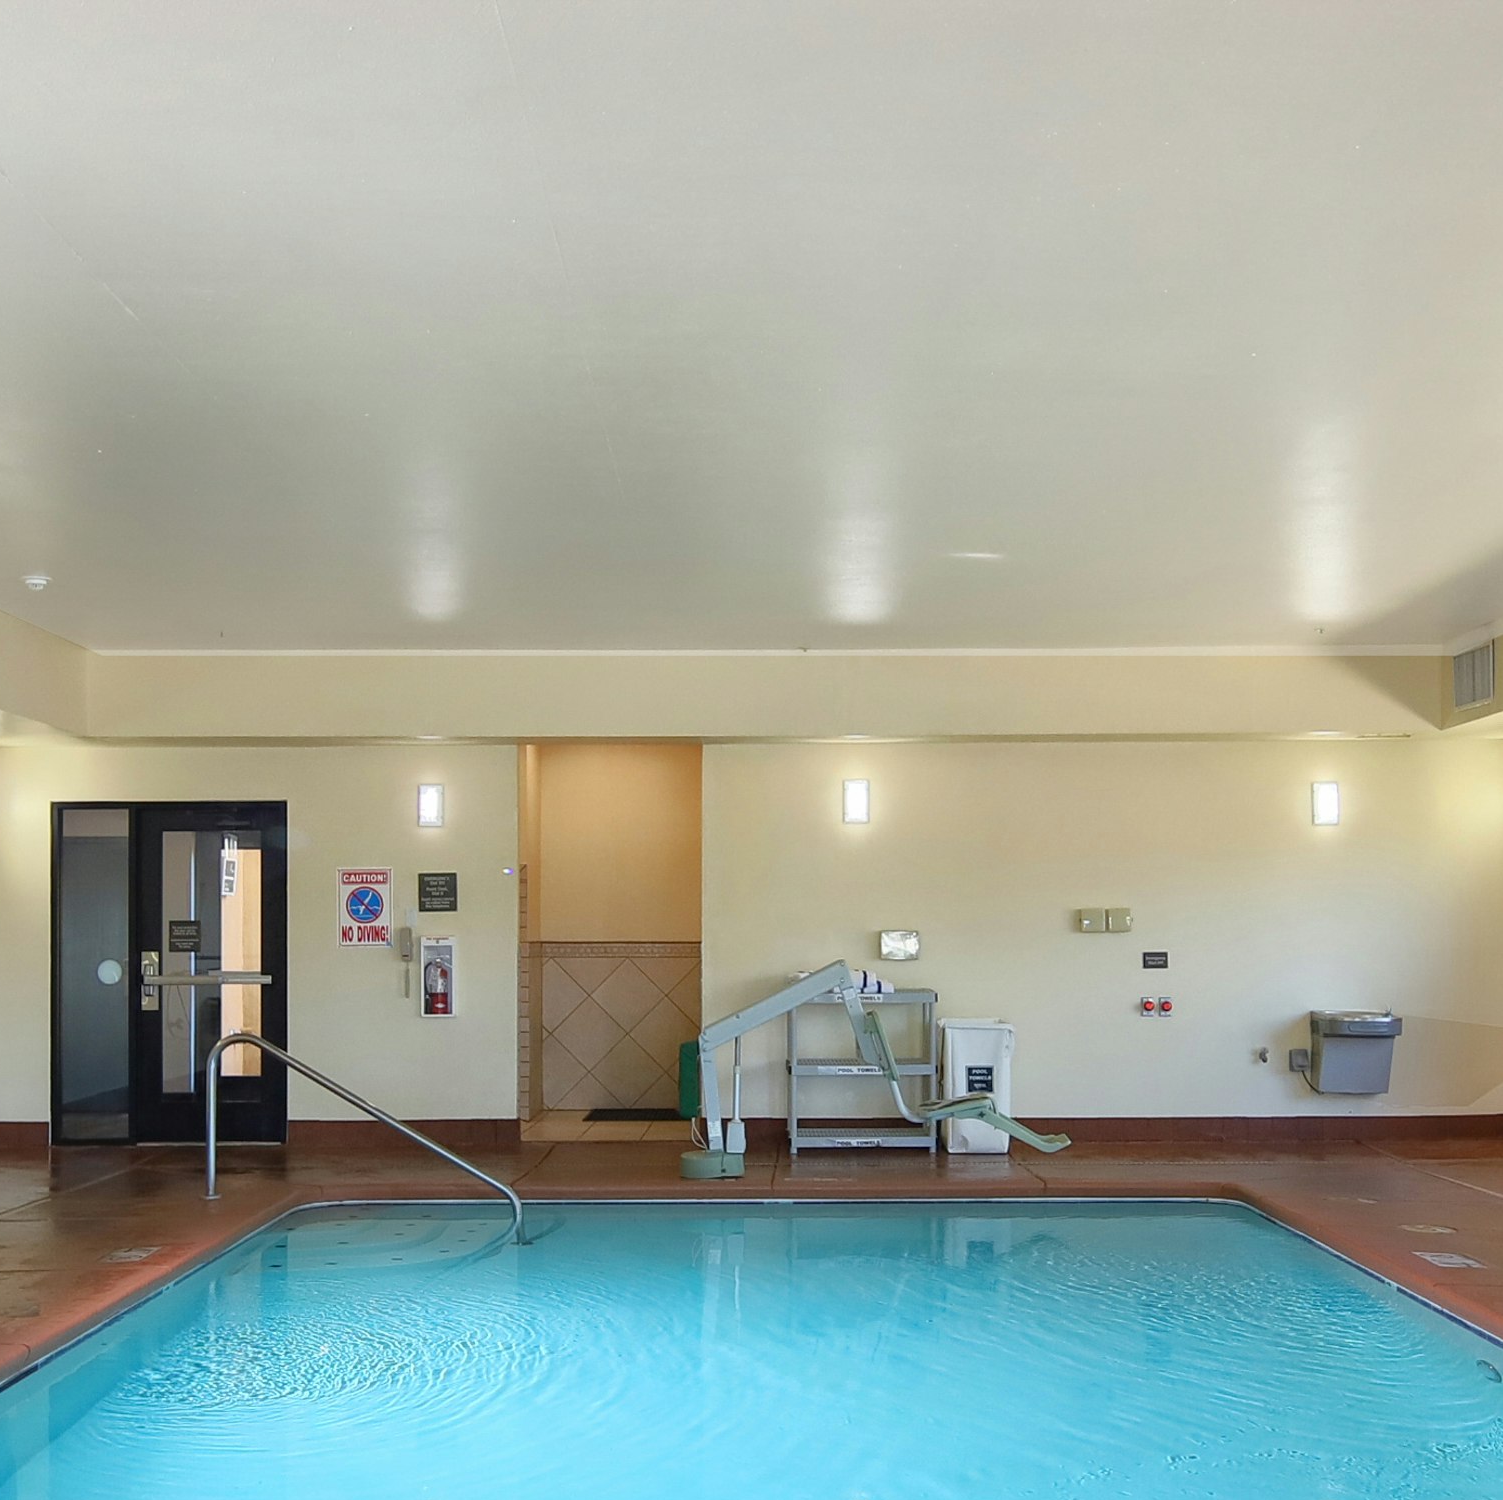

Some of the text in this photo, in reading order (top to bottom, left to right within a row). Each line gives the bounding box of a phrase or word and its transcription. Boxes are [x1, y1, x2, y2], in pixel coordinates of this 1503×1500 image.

[343, 873, 387, 882] CAUTION!
[341, 925, 389, 943] NO DIVING!
